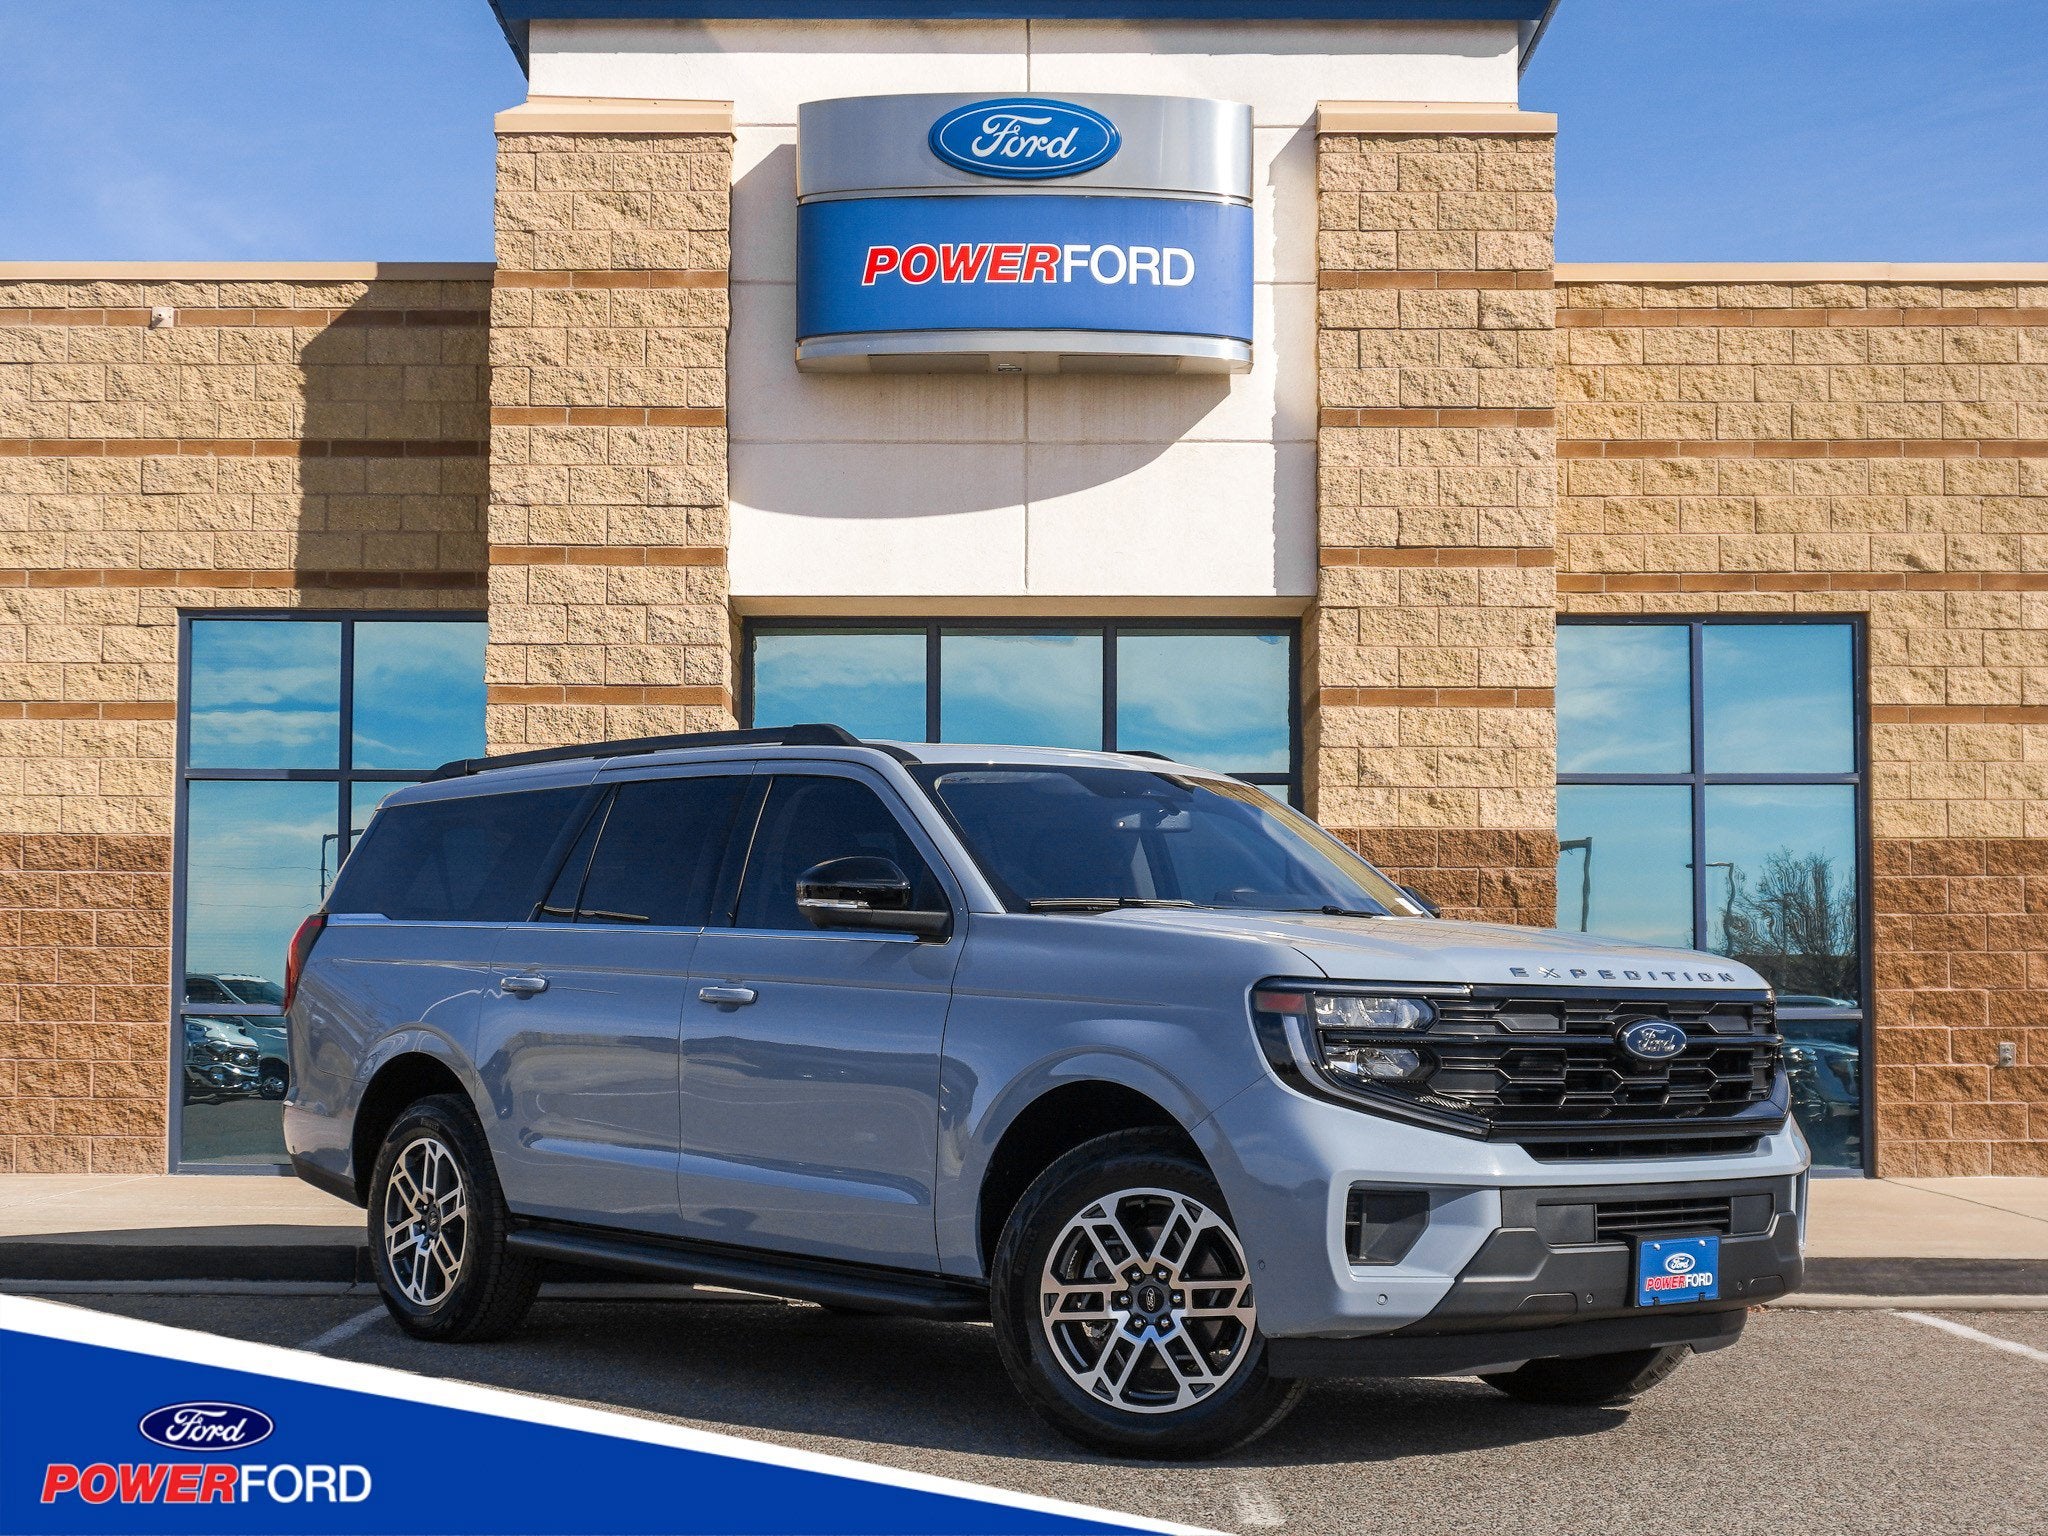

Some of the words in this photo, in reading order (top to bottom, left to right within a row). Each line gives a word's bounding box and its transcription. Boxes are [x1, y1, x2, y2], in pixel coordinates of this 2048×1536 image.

[971, 113, 1080, 159] Ford
[1509, 966, 1736, 983] EXPEDITION
[1638, 1028, 1676, 1052] Ford
[1671, 1257, 1690, 1270] Ford
